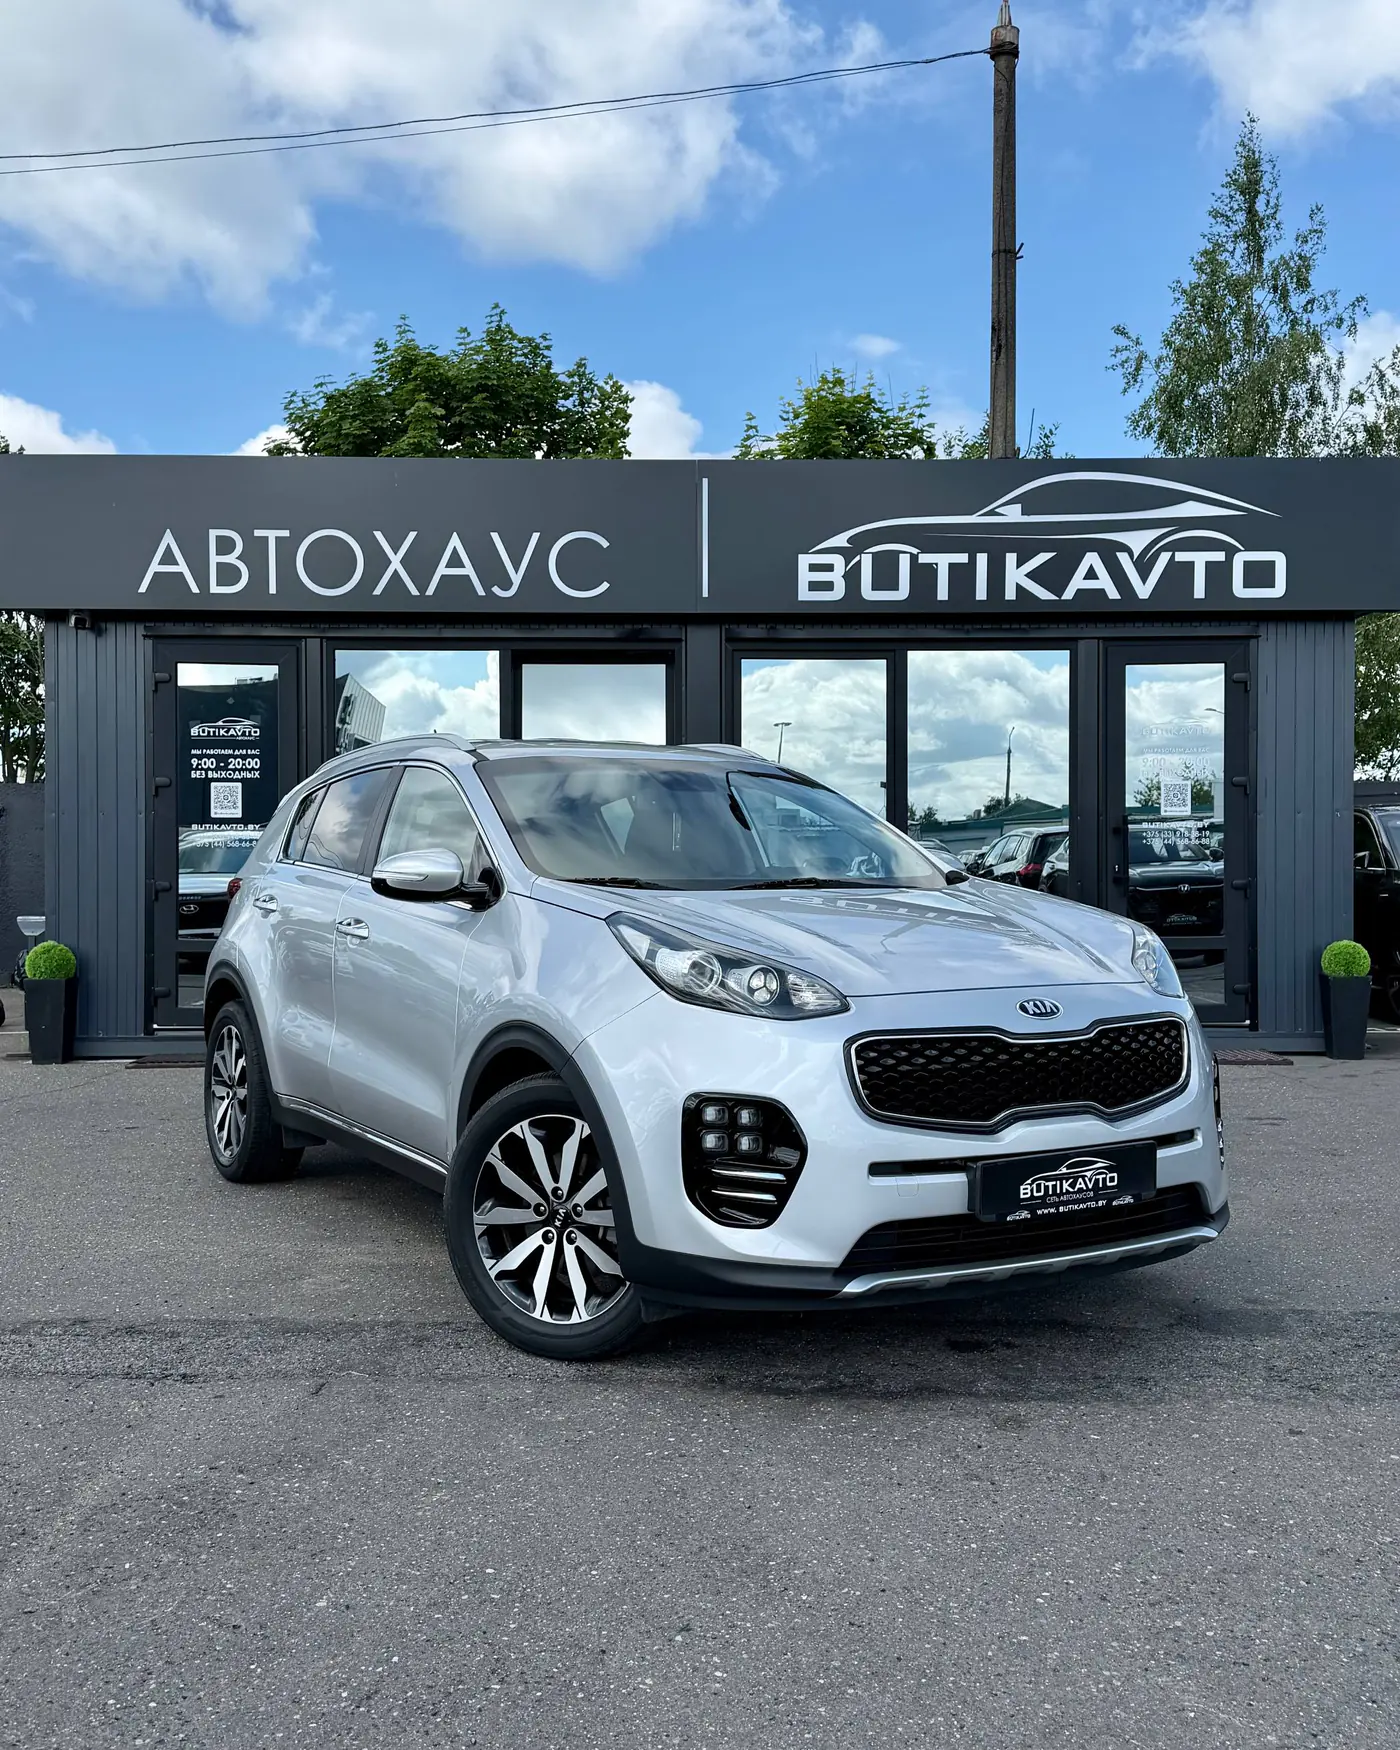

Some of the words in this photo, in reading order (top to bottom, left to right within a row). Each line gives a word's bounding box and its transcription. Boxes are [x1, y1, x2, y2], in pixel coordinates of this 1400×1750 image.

[137, 528, 611, 599] АВТОХАУС
[797, 550, 1287, 601] BUTIKAVTO
[191, 728, 260, 736] BUTIKAVTO
[191, 758, 216, 769] 9:00
[228, 758, 260, 769] 20:00
[208, 771, 260, 779] ВЫХОДНЫХ
[1022, 1000, 1058, 1014] KIA
[1019, 1172, 1118, 1199] BUTIKAVTO
[1060, 1191, 1094, 1202] АВТОХАУСОВ
[1058, 1200, 1108, 1212] BUTIKAVTO.BY
[554, 1209, 567, 1227] KIA
